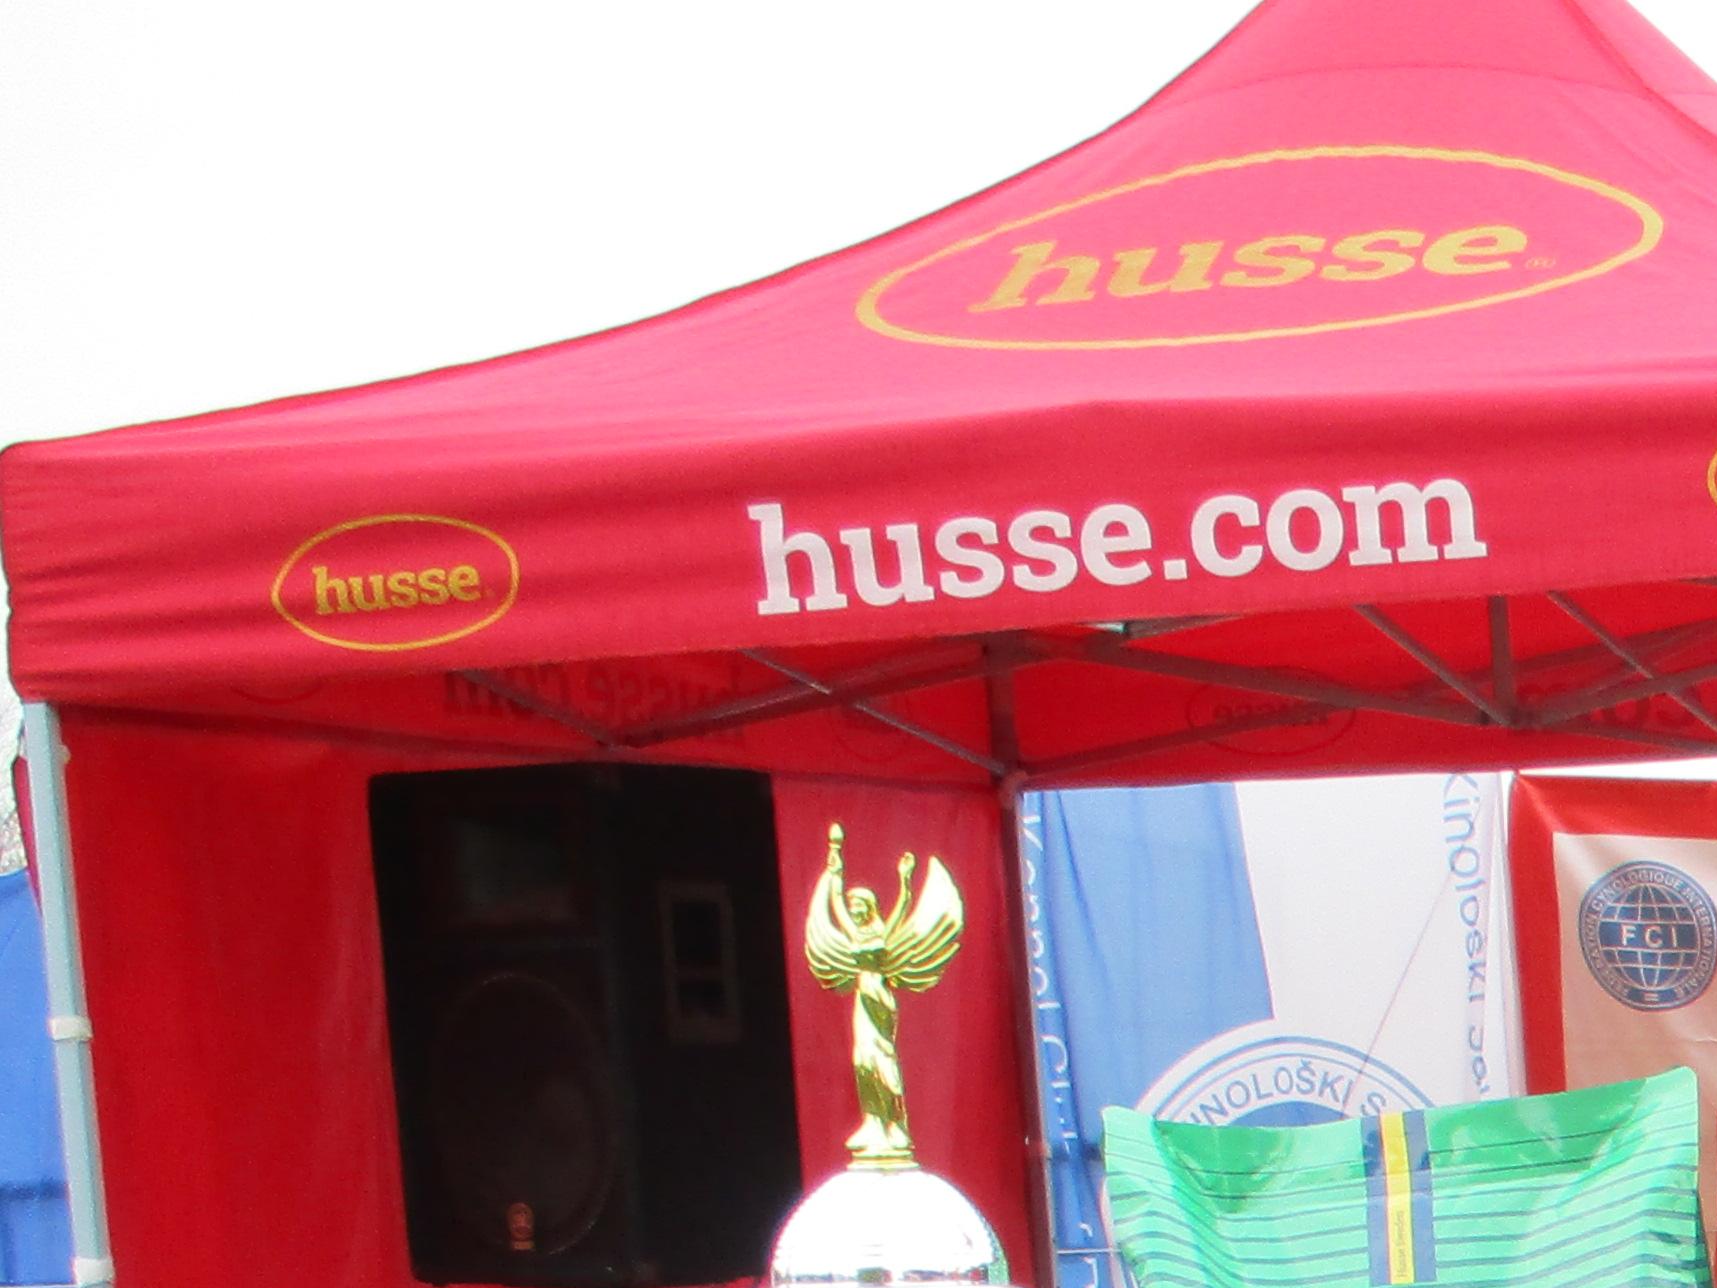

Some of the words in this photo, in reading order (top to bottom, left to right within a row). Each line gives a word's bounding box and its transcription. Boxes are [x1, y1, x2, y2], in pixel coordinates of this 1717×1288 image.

[969, 220, 1532, 312] husse
[748, 476, 1487, 616] husse.com
[312, 559, 480, 615] husse
[1620, 924, 1677, 948] FCI
